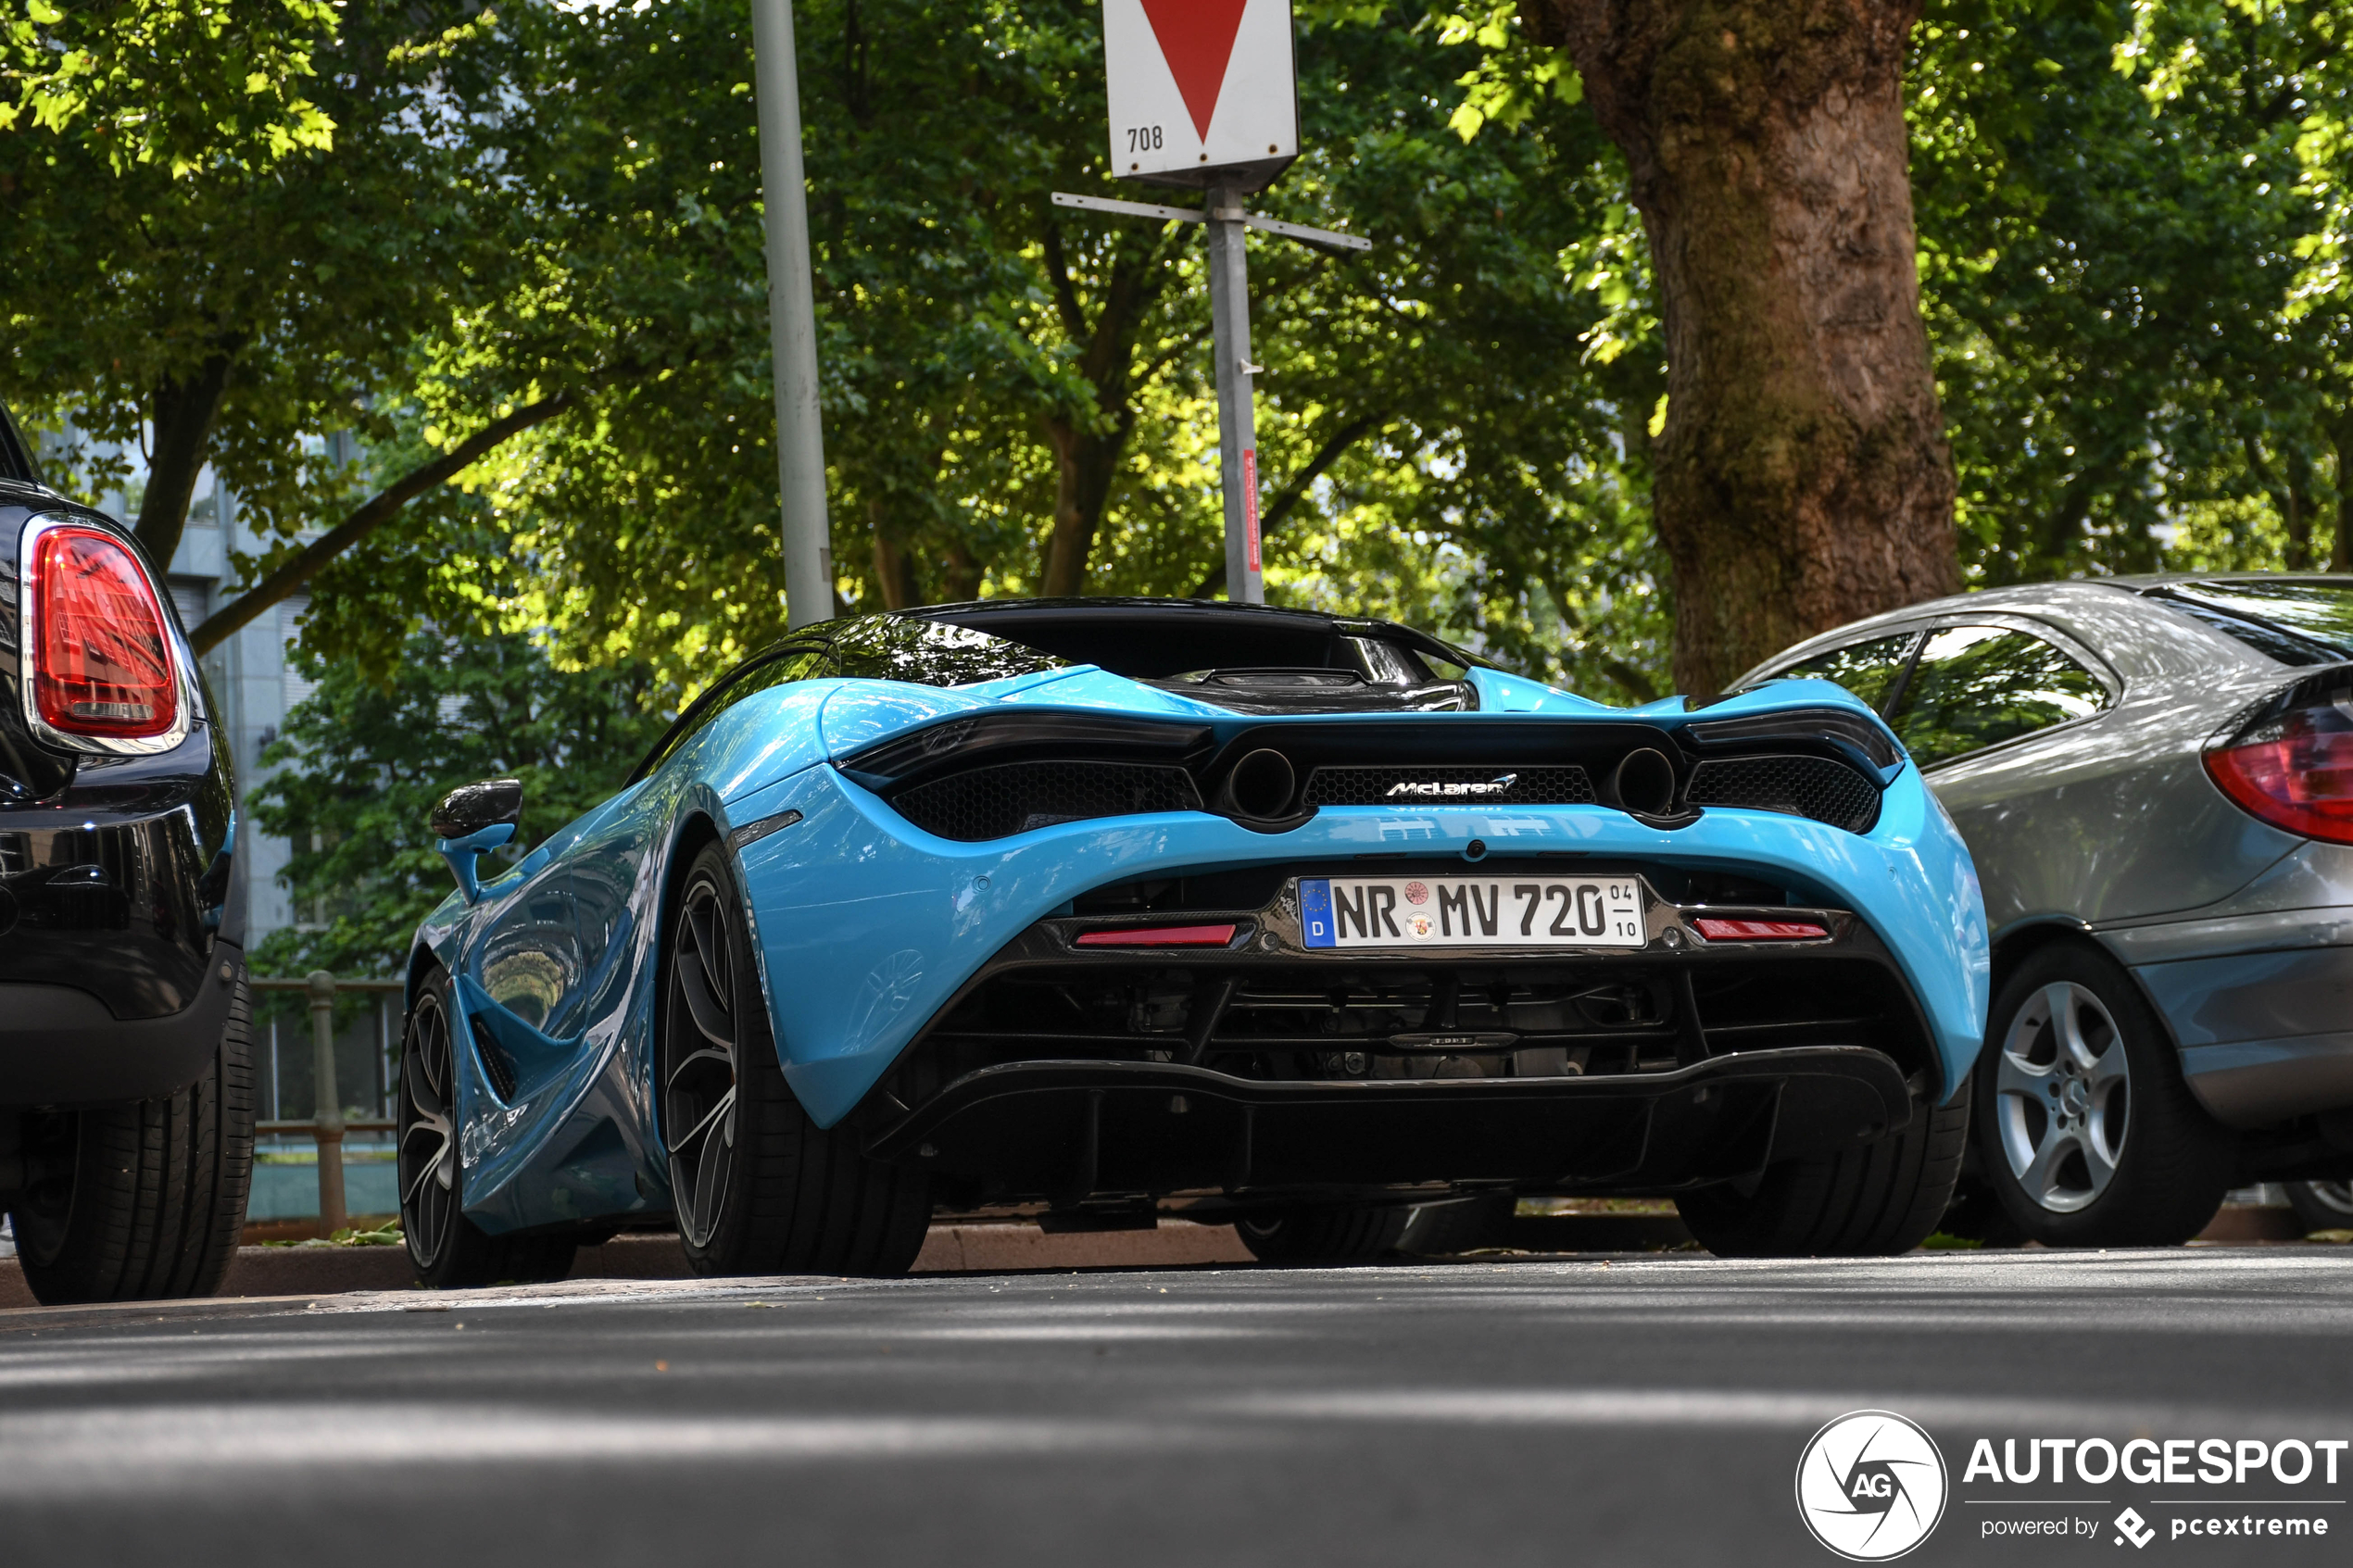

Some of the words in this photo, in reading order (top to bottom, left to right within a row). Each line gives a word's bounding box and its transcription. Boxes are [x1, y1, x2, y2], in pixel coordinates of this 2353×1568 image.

[1127, 125, 1163, 153] 708
[1386, 781, 1506, 797] McLaren
[1610, 884, 1632, 900] 04
[1335, 885, 1401, 938] NR
[1438, 884, 1499, 936] MV
[1515, 884, 1606, 936] 720
[1312, 921, 1324, 936] D
[1617, 922, 1636, 937] 10
